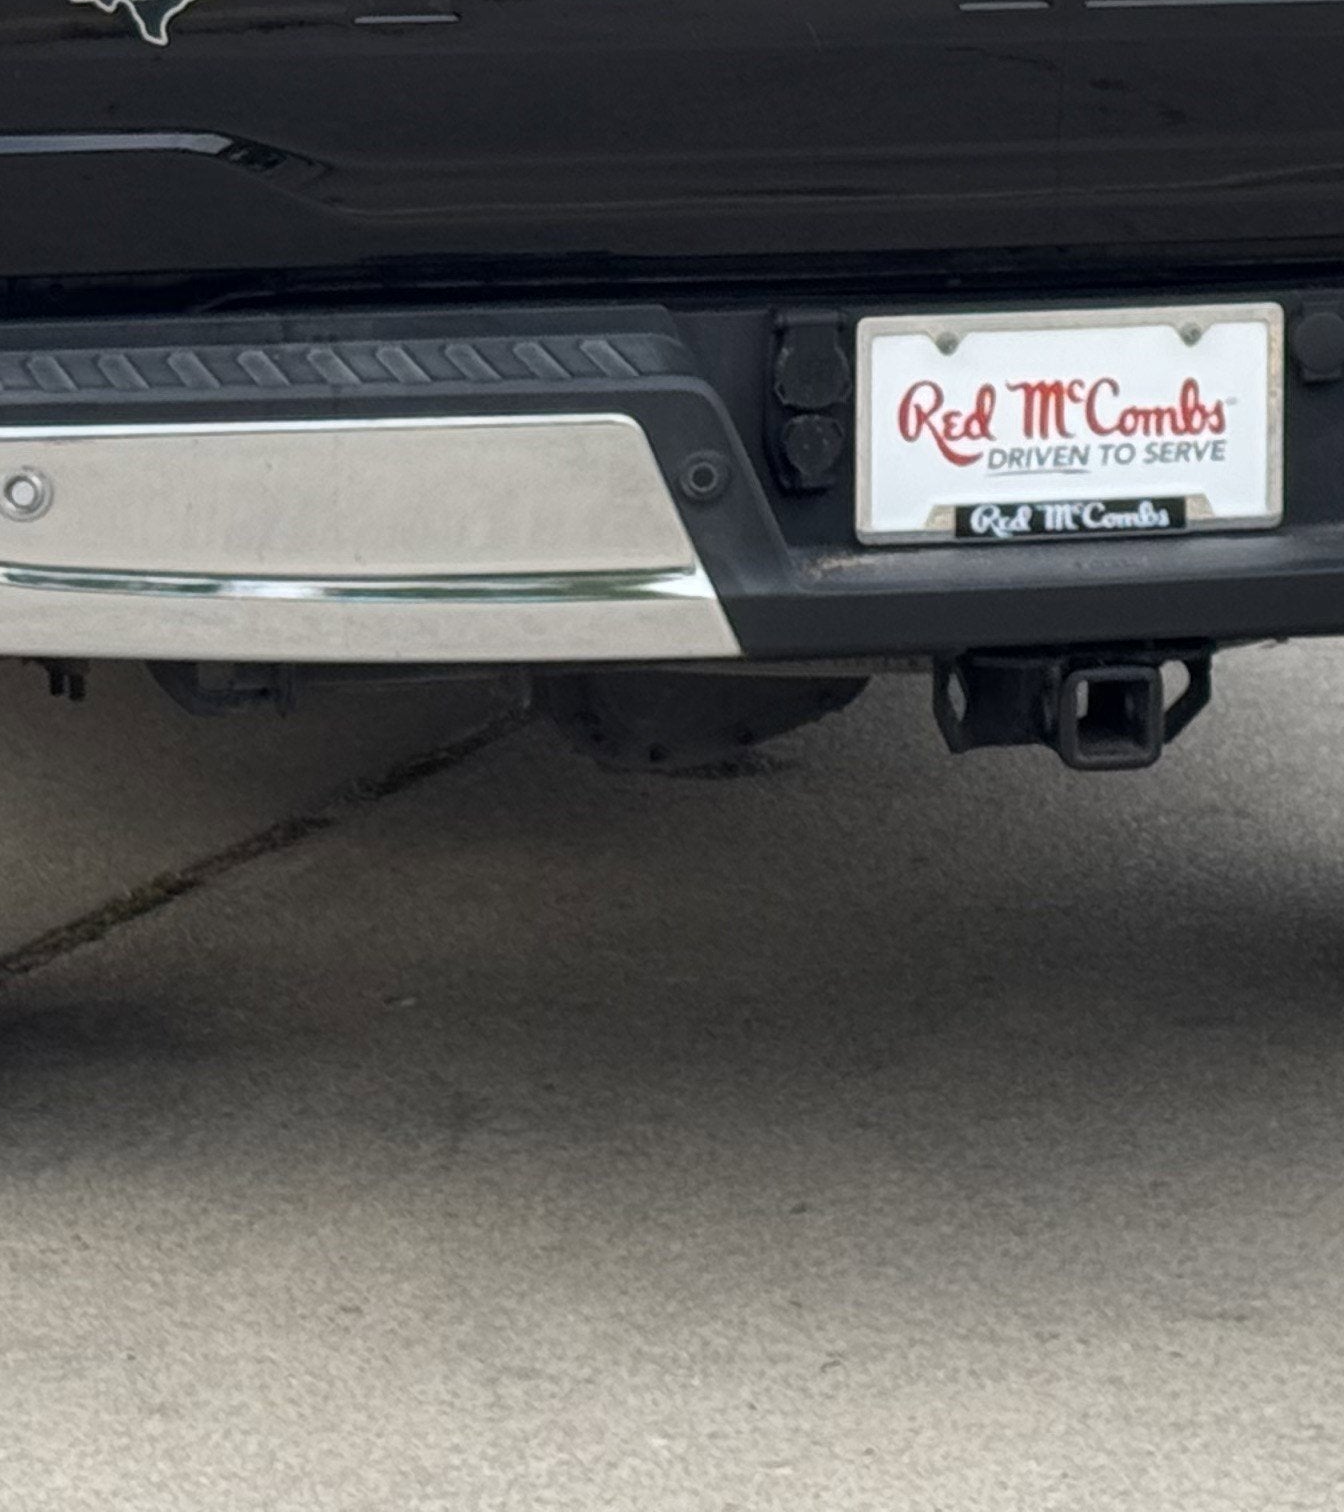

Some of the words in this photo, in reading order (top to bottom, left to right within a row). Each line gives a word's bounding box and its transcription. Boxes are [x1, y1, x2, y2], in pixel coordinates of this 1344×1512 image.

[897, 380, 997, 466] Red
[1005, 377, 1226, 440] McCombs
[987, 443, 1091, 471] DRIVEN
[1100, 442, 1136, 464] TO
[1142, 439, 1227, 464] SERVE
[970, 502, 1032, 538] Red
[1036, 501, 1169, 530] McCombs
